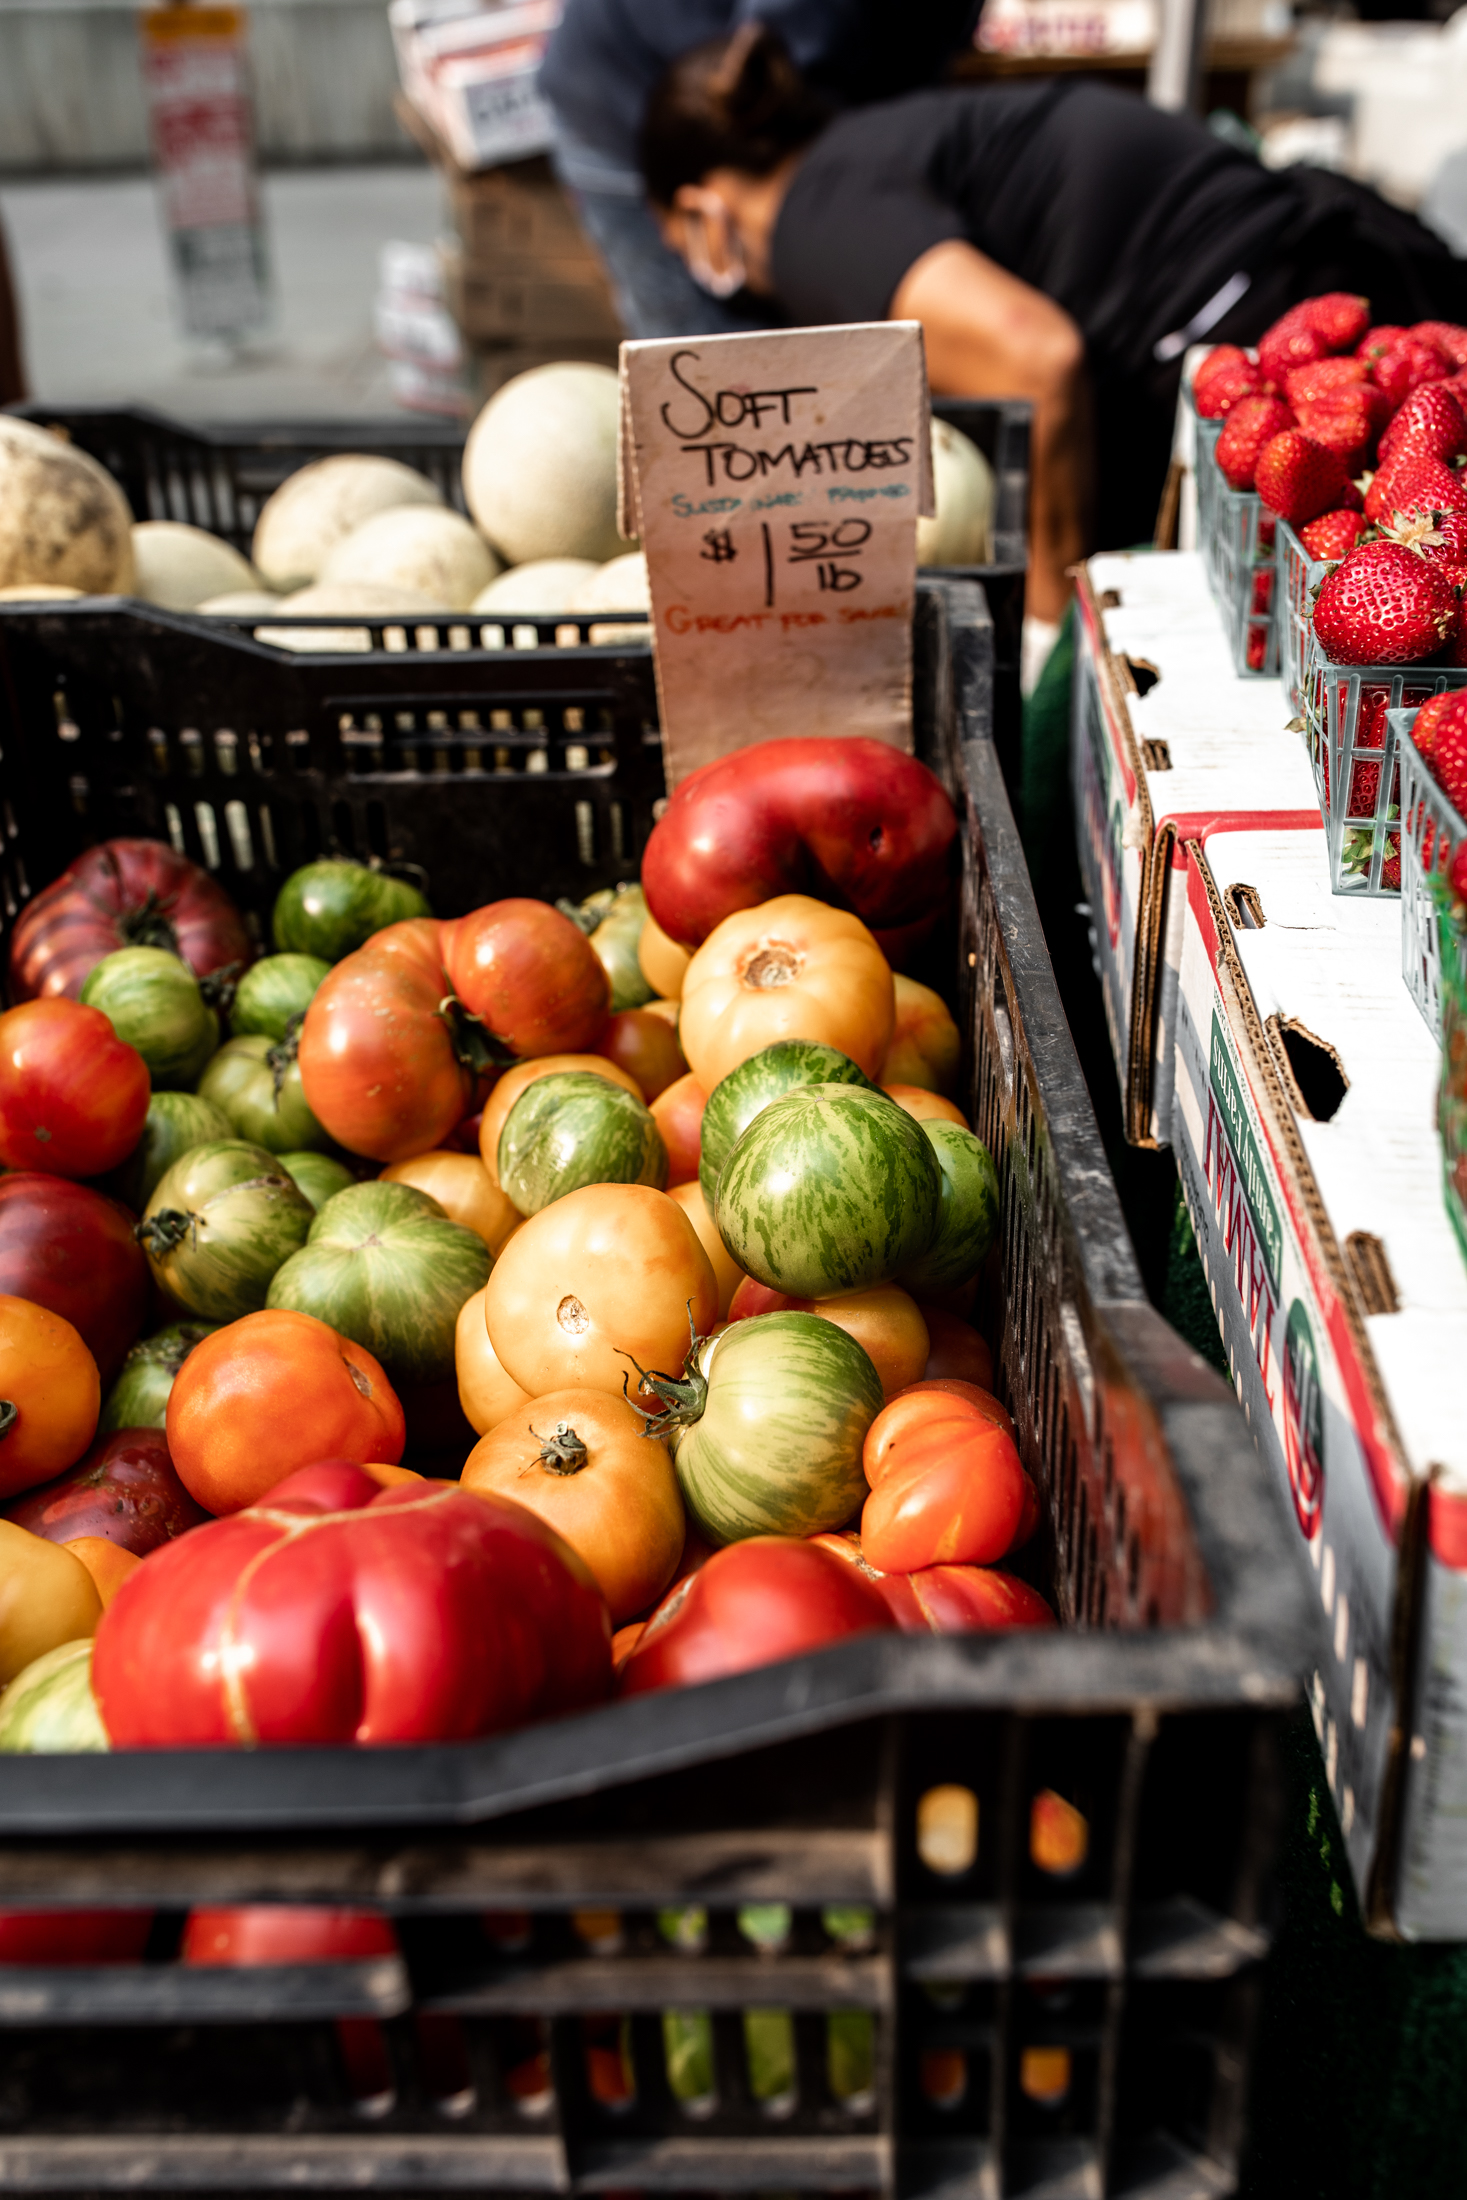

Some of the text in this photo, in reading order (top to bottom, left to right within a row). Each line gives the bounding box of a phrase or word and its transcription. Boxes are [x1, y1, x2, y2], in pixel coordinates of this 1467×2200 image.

[660, 350, 818, 440] SOFT
[681, 437, 914, 487] TOMATOES
[700, 528, 737, 564] $
[789, 518, 873, 554] 50
[663, 604, 772, 637] GREAT
[1212, 1034, 1243, 1163] Farms
[1242, 1121, 1281, 1288] Family
[1203, 1086, 1275, 1418] TAMAI
